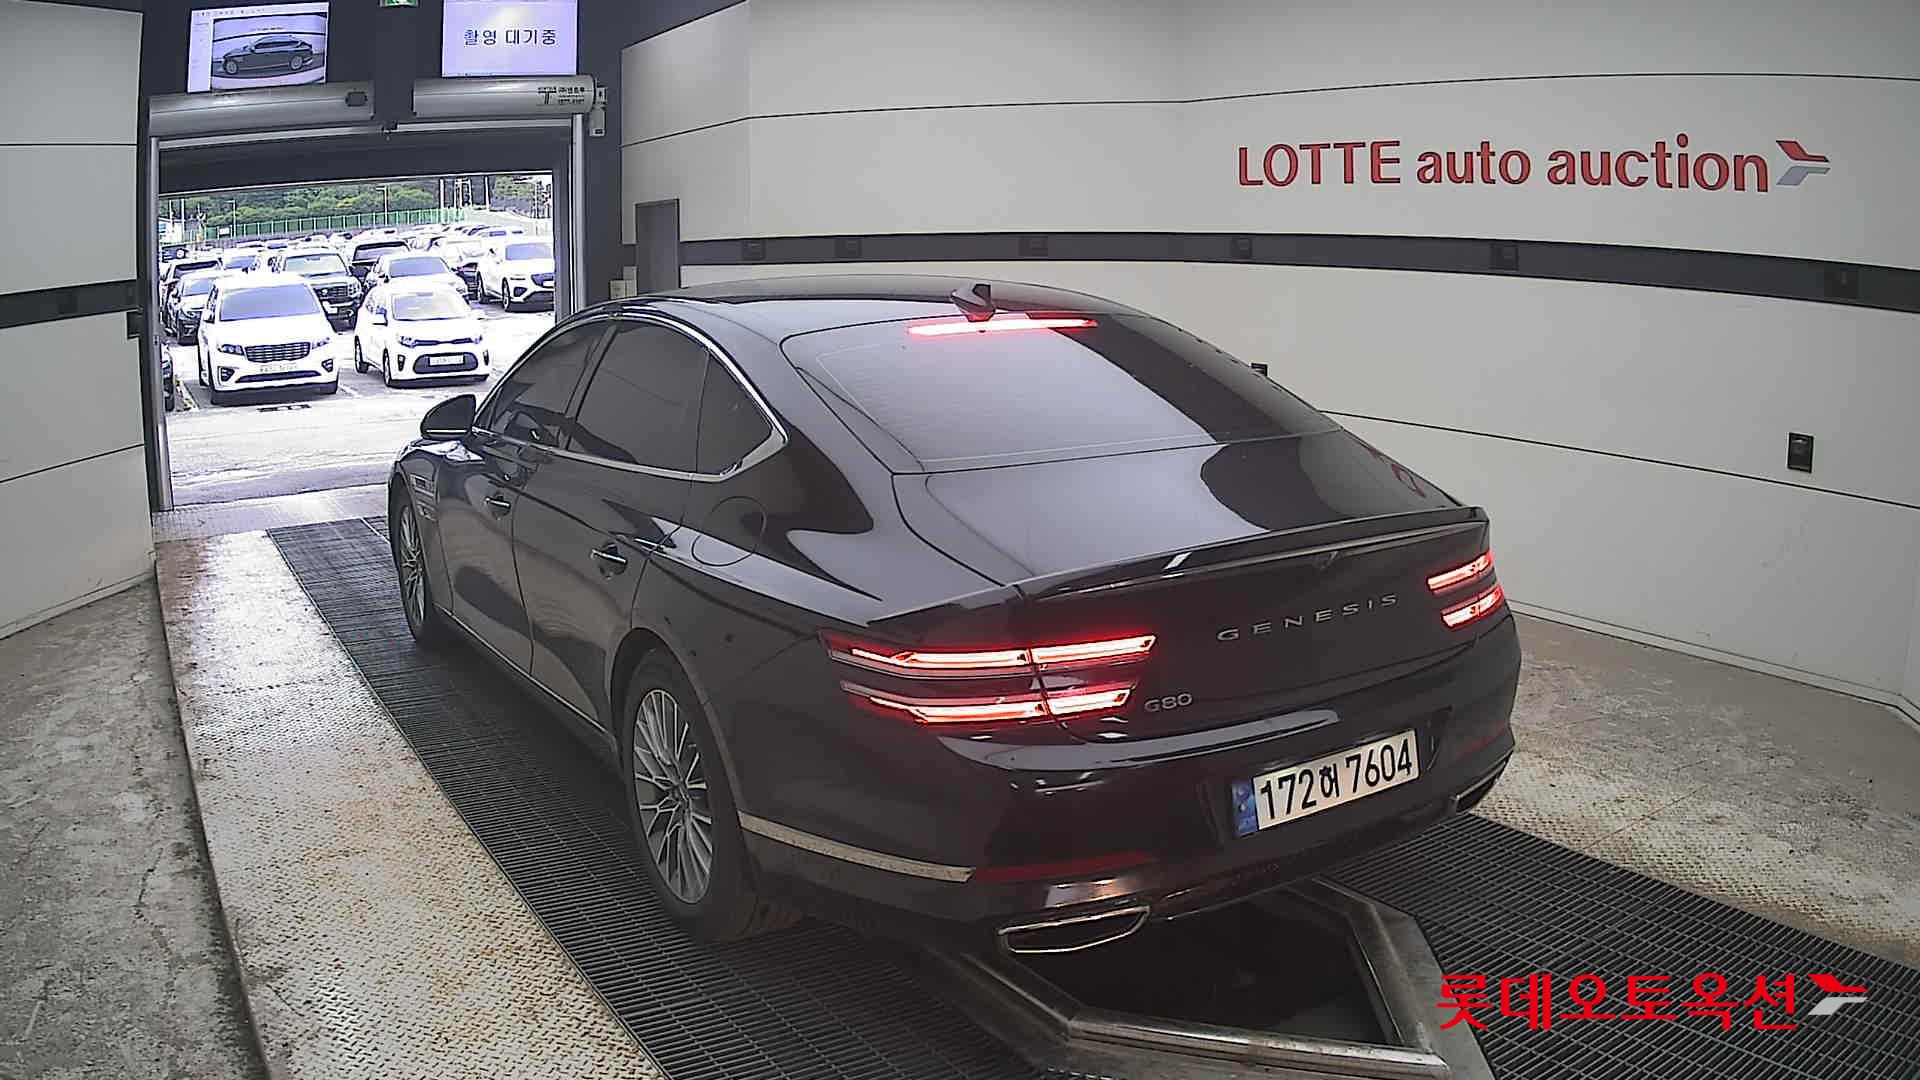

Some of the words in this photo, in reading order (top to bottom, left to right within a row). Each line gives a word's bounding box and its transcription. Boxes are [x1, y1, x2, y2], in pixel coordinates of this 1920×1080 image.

[505, 29, 556, 46] 대기중
[1238, 141, 1401, 187] LOTTE
[1416, 141, 1532, 186] auto
[1547, 134, 1769, 193] auction
[1217, 594, 1397, 641] GENESIS
[1144, 693, 1193, 713] G80
[1345, 738, 1413, 793] 7604
